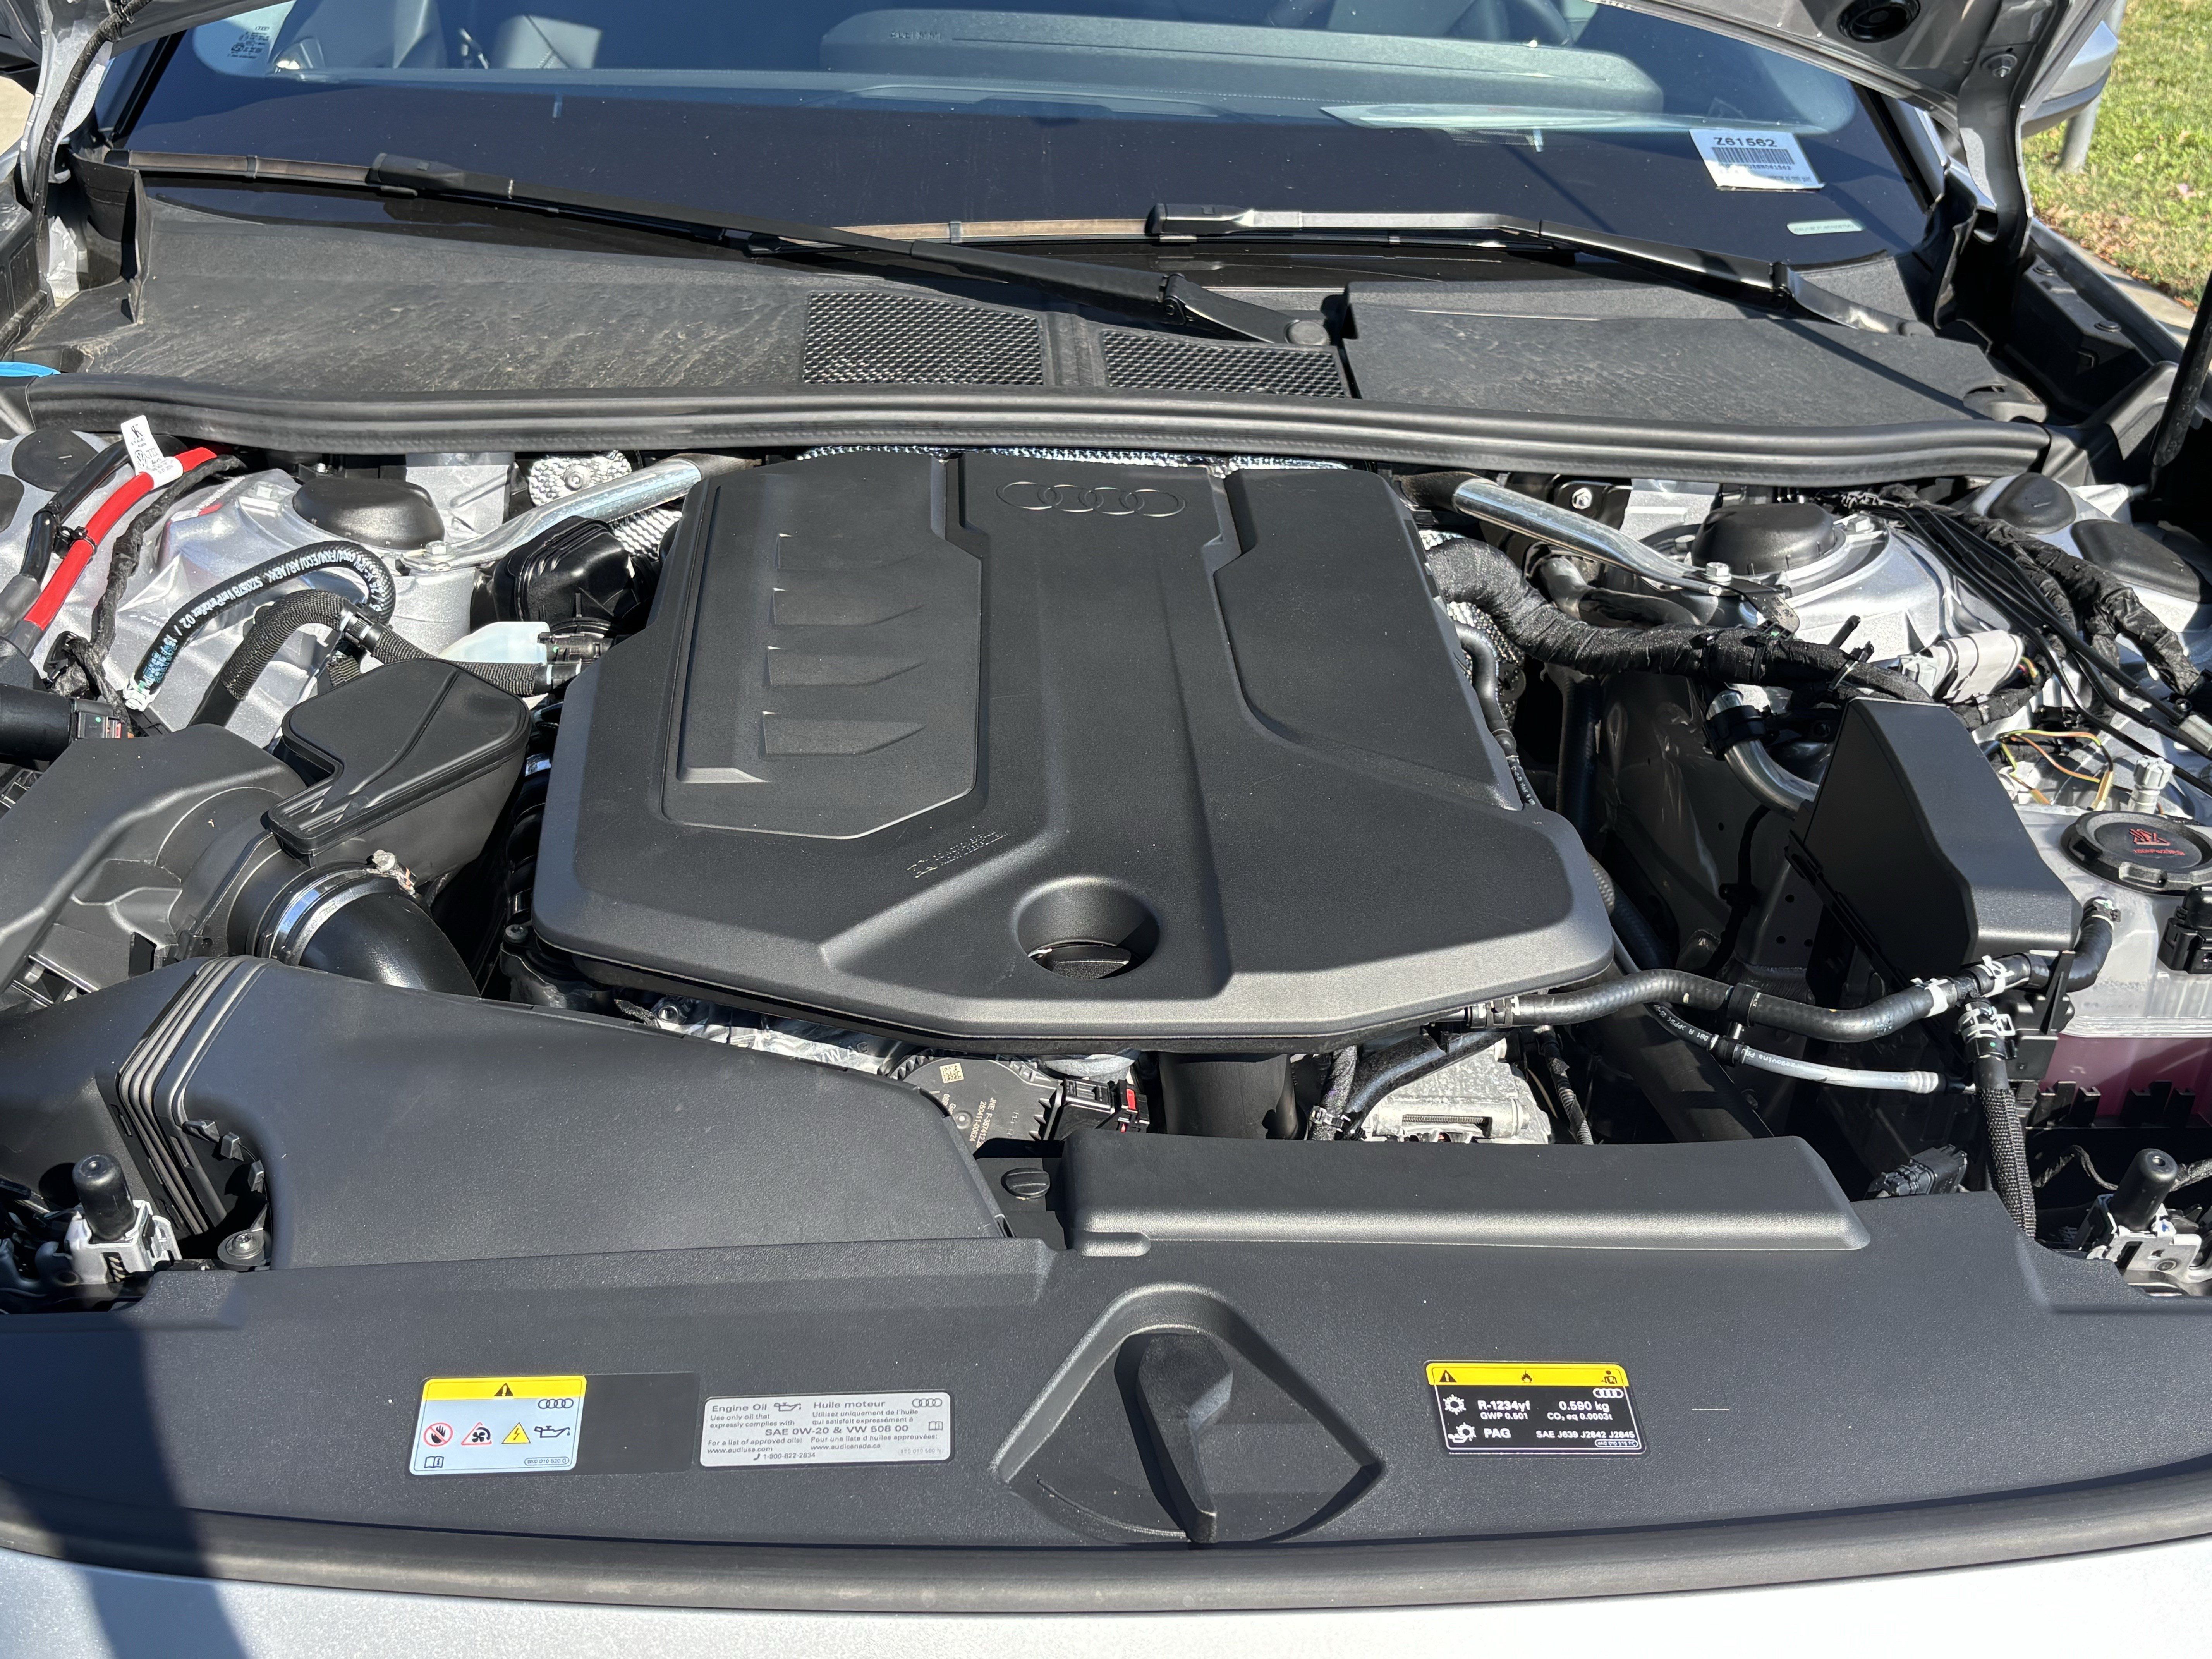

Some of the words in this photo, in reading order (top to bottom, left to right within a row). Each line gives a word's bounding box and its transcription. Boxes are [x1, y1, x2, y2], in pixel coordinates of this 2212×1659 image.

[1714, 137, 1778, 147] Z61562
[179, 613, 196, 627] 02
[1477, 1400, 1530, 1412] R-1234yf
[1559, 1401, 1592, 1411] 0.590
[1594, 1401, 1609, 1413] kg
[792, 1427, 829, 1435] 0W-20
[1484, 1428, 1511, 1439] PAG
